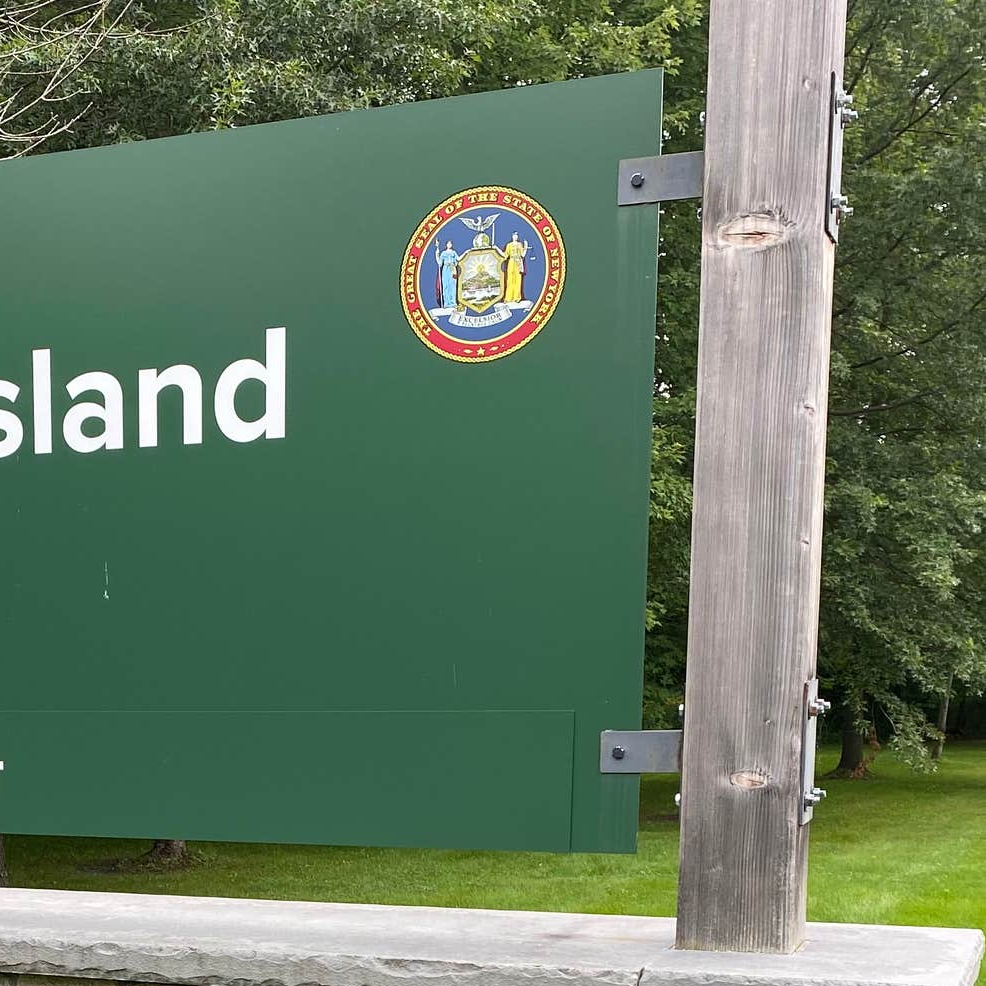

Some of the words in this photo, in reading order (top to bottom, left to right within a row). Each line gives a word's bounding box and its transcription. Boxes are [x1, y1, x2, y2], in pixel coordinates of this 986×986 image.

[445, 199, 465, 215] OF
[468, 192, 498, 204] THE
[502, 194, 542, 224] STATE
[415, 215, 444, 249] SEAL
[542, 226, 556, 243] OF
[406, 255, 417, 304] GREAT
[412, 309, 432, 336] THE
